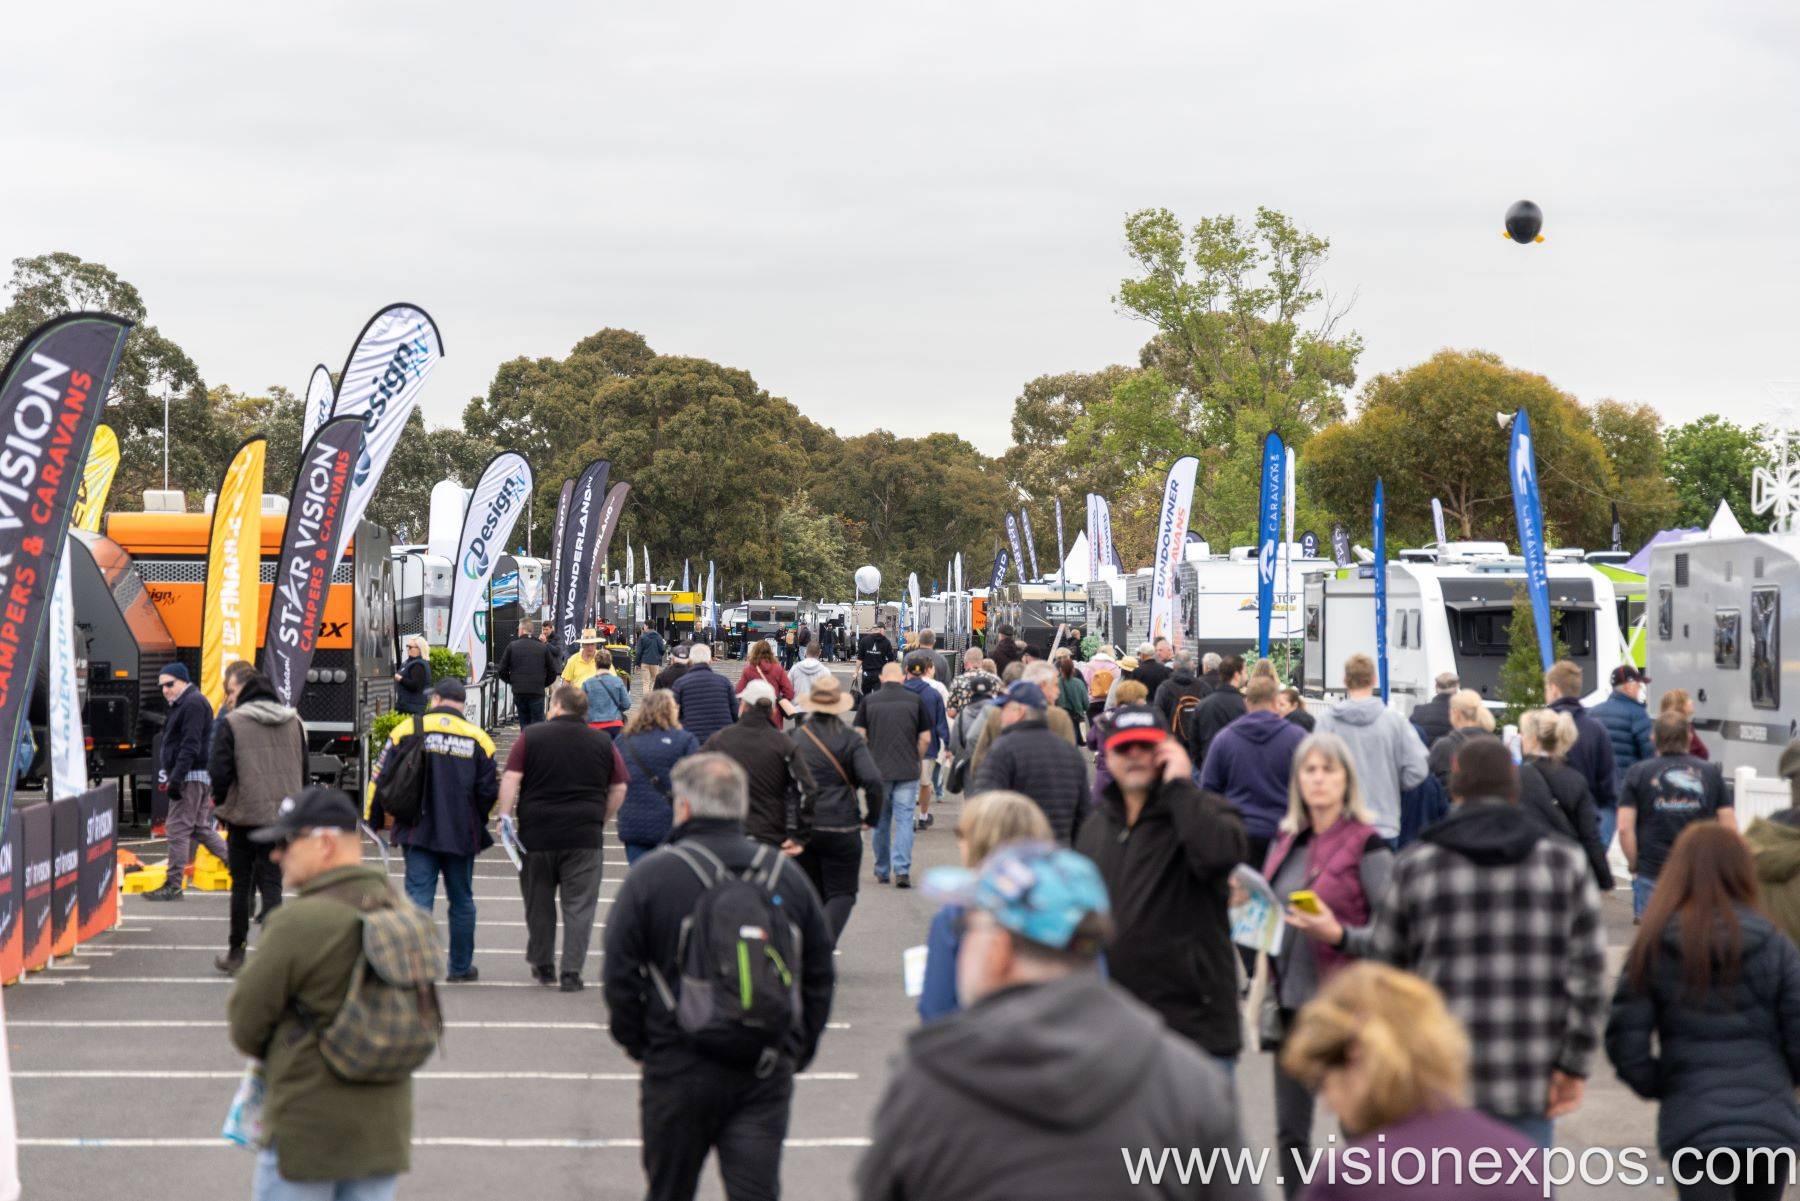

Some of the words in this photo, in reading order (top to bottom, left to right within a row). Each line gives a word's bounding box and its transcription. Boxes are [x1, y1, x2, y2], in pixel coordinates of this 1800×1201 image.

[364, 343, 412, 434] esign
[31, 369, 92, 525] CARAVANS
[295, 442, 339, 551] VISION
[320, 450, 350, 541] CARAVANS
[469, 477, 515, 560] Design
[1157, 479, 1180, 598] SUNDOWNER
[1269, 454, 1280, 532] CARAVANS
[22, 536, 44, 557] &
[316, 550, 327, 561] &
[564, 487, 592, 620] WONDERLAND
[300, 564, 325, 652] CAMPERS
